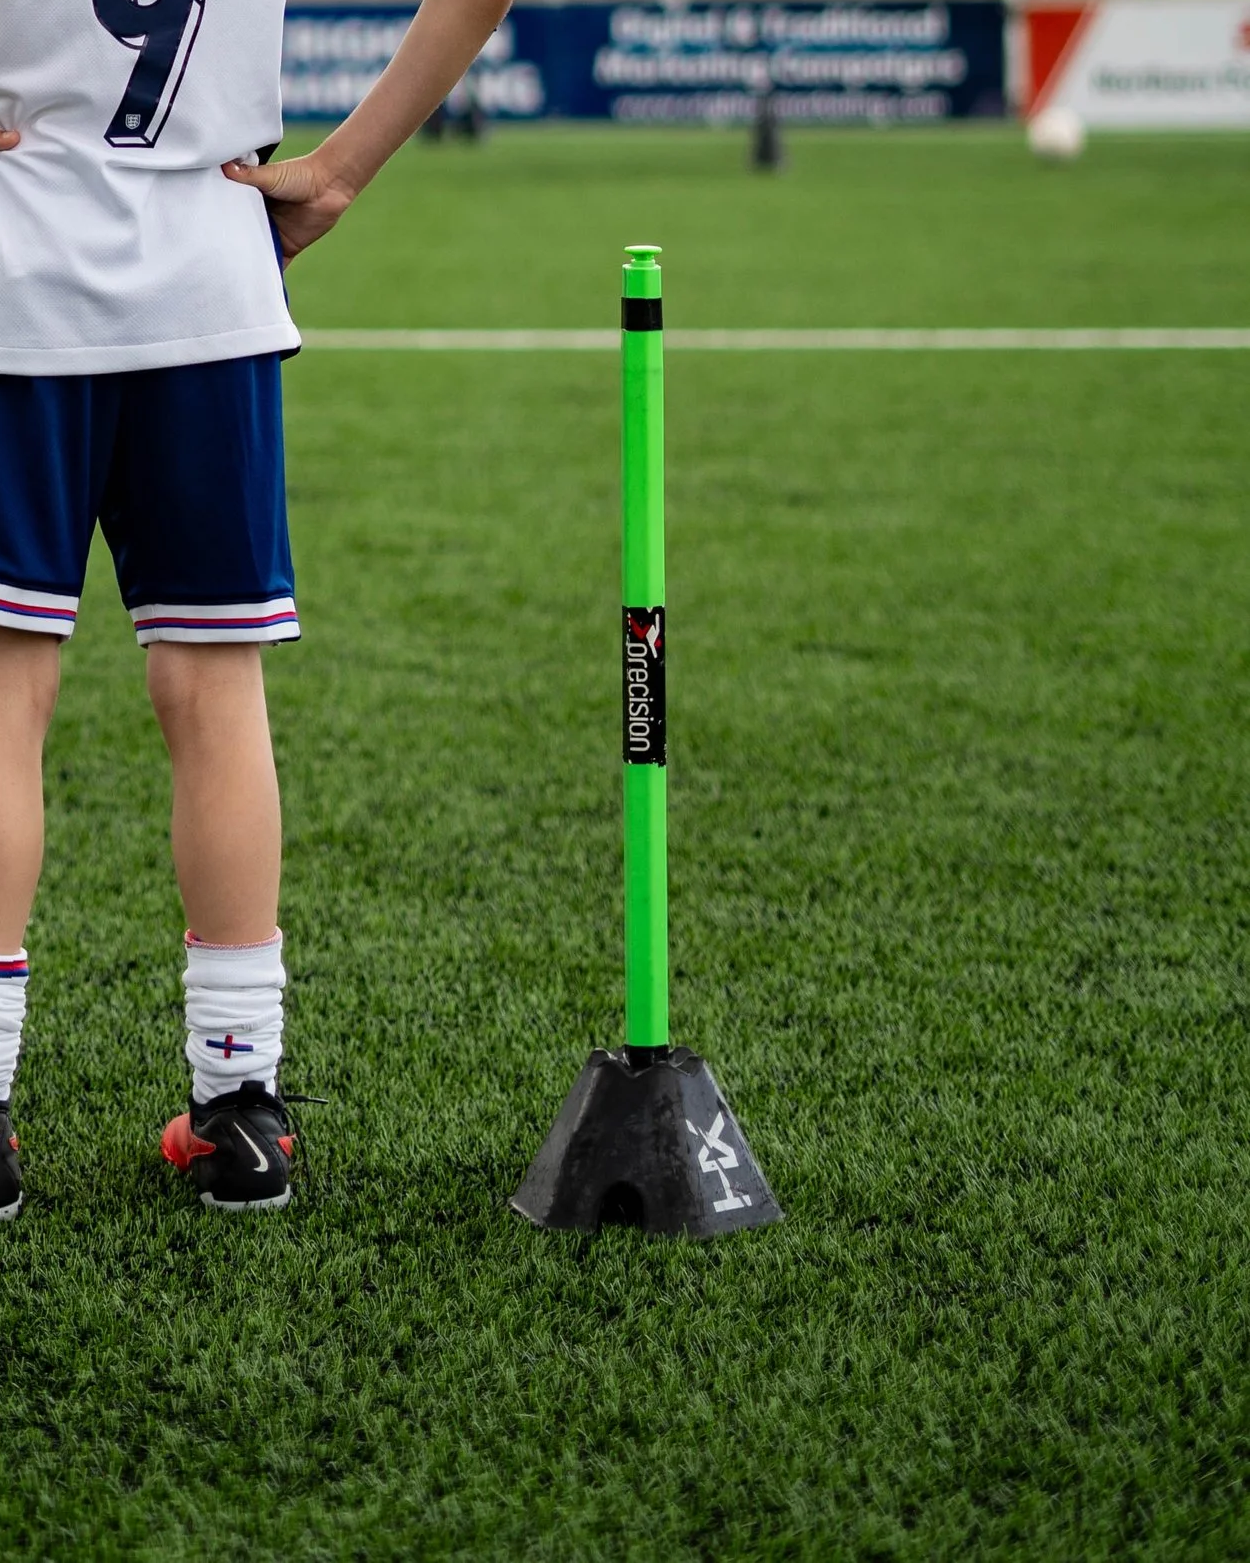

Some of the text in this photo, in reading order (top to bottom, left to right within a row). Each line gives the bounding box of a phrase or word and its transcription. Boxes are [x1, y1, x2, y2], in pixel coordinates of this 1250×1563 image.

[615, 8, 722, 50] Digital
[763, 7, 946, 43] Traditional
[598, 49, 768, 90] Marketing
[626, 642, 654, 752] precision
